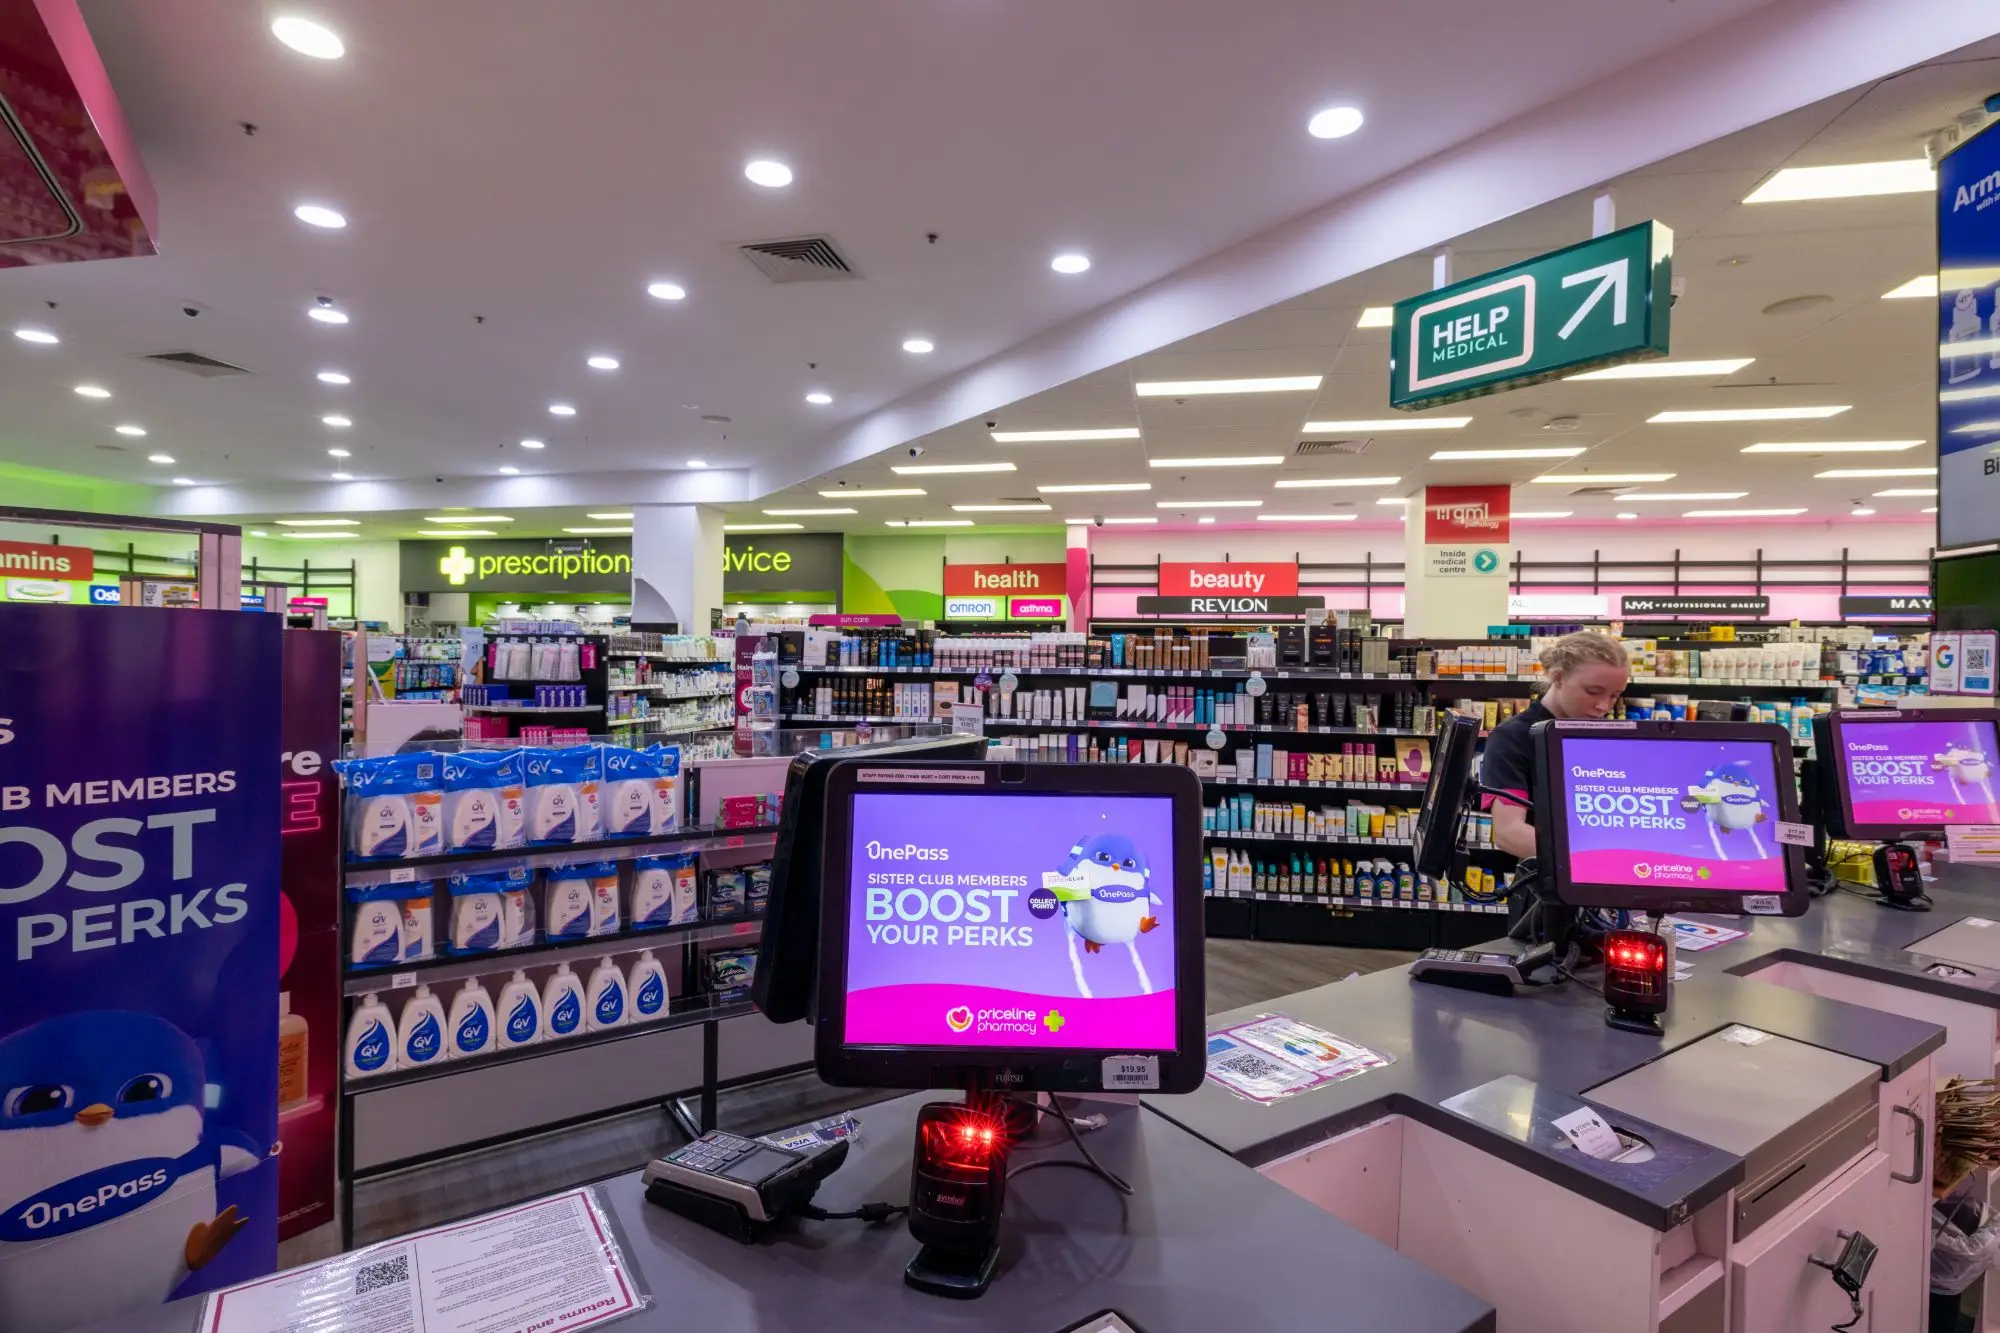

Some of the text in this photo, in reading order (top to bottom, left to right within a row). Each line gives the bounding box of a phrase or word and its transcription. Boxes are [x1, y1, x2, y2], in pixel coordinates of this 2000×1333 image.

[1432, 305, 1509, 348] HELP
[1432, 332, 1509, 363] MEDICAL
[1453, 503, 1489, 525] qml
[479, 546, 792, 580] prescription dvice
[973, 570, 1039, 589] health
[1189, 569, 1266, 592] beauty
[1019, 603, 1053, 613] asthma
[1191, 598, 1268, 613] REVLON
[1624, 601, 1654, 610] NYX
[1847, 742, 1889, 751] OnePass
[528, 759, 551, 776] QV
[607, 755, 631, 771] QV
[1851, 761, 1925, 776] BOOST
[443, 765, 468, 781] QV
[1571, 765, 1627, 778] OnePass
[353, 771, 378, 788] QV
[1854, 776, 1935, 785] YOUR PERKS
[46, 770, 236, 808] MEMBERS
[1575, 784, 1679, 795] SISTER CLUB MEMBERS
[1575, 792, 1674, 816] BOOST
[1577, 814, 1686, 830] YOUR PERKS
[864, 840, 949, 861] OnePass
[1653, 864, 1693, 873] priceline
[1653, 871, 1694, 881] pharmacy
[867, 873, 1028, 886] SISTER CLUB MEMBERS
[1098, 889, 1135, 898] OnePass
[865, 887, 1019, 923] BOOST
[17, 882, 249, 961] PERKS
[866, 924, 1034, 947] YOUR PERKS
[643, 990, 658, 1004] QV
[602, 999, 618, 1012] QV
[557, 1008, 574, 1021] QV
[977, 1008, 1036, 1021] priceline
[513, 1016, 531, 1030] QV
[977, 1021, 1037, 1035] pharmacy
[463, 1024, 482, 1039] QV
[413, 1034, 434, 1049] QV
[361, 1042, 383, 1058] QV
[1120, 1065, 1146, 1073] $19.95
[785, 1138, 810, 1148] VISA
[18, 1168, 168, 1229] OnePass
[526, 1296, 617, 1333] Returns and
